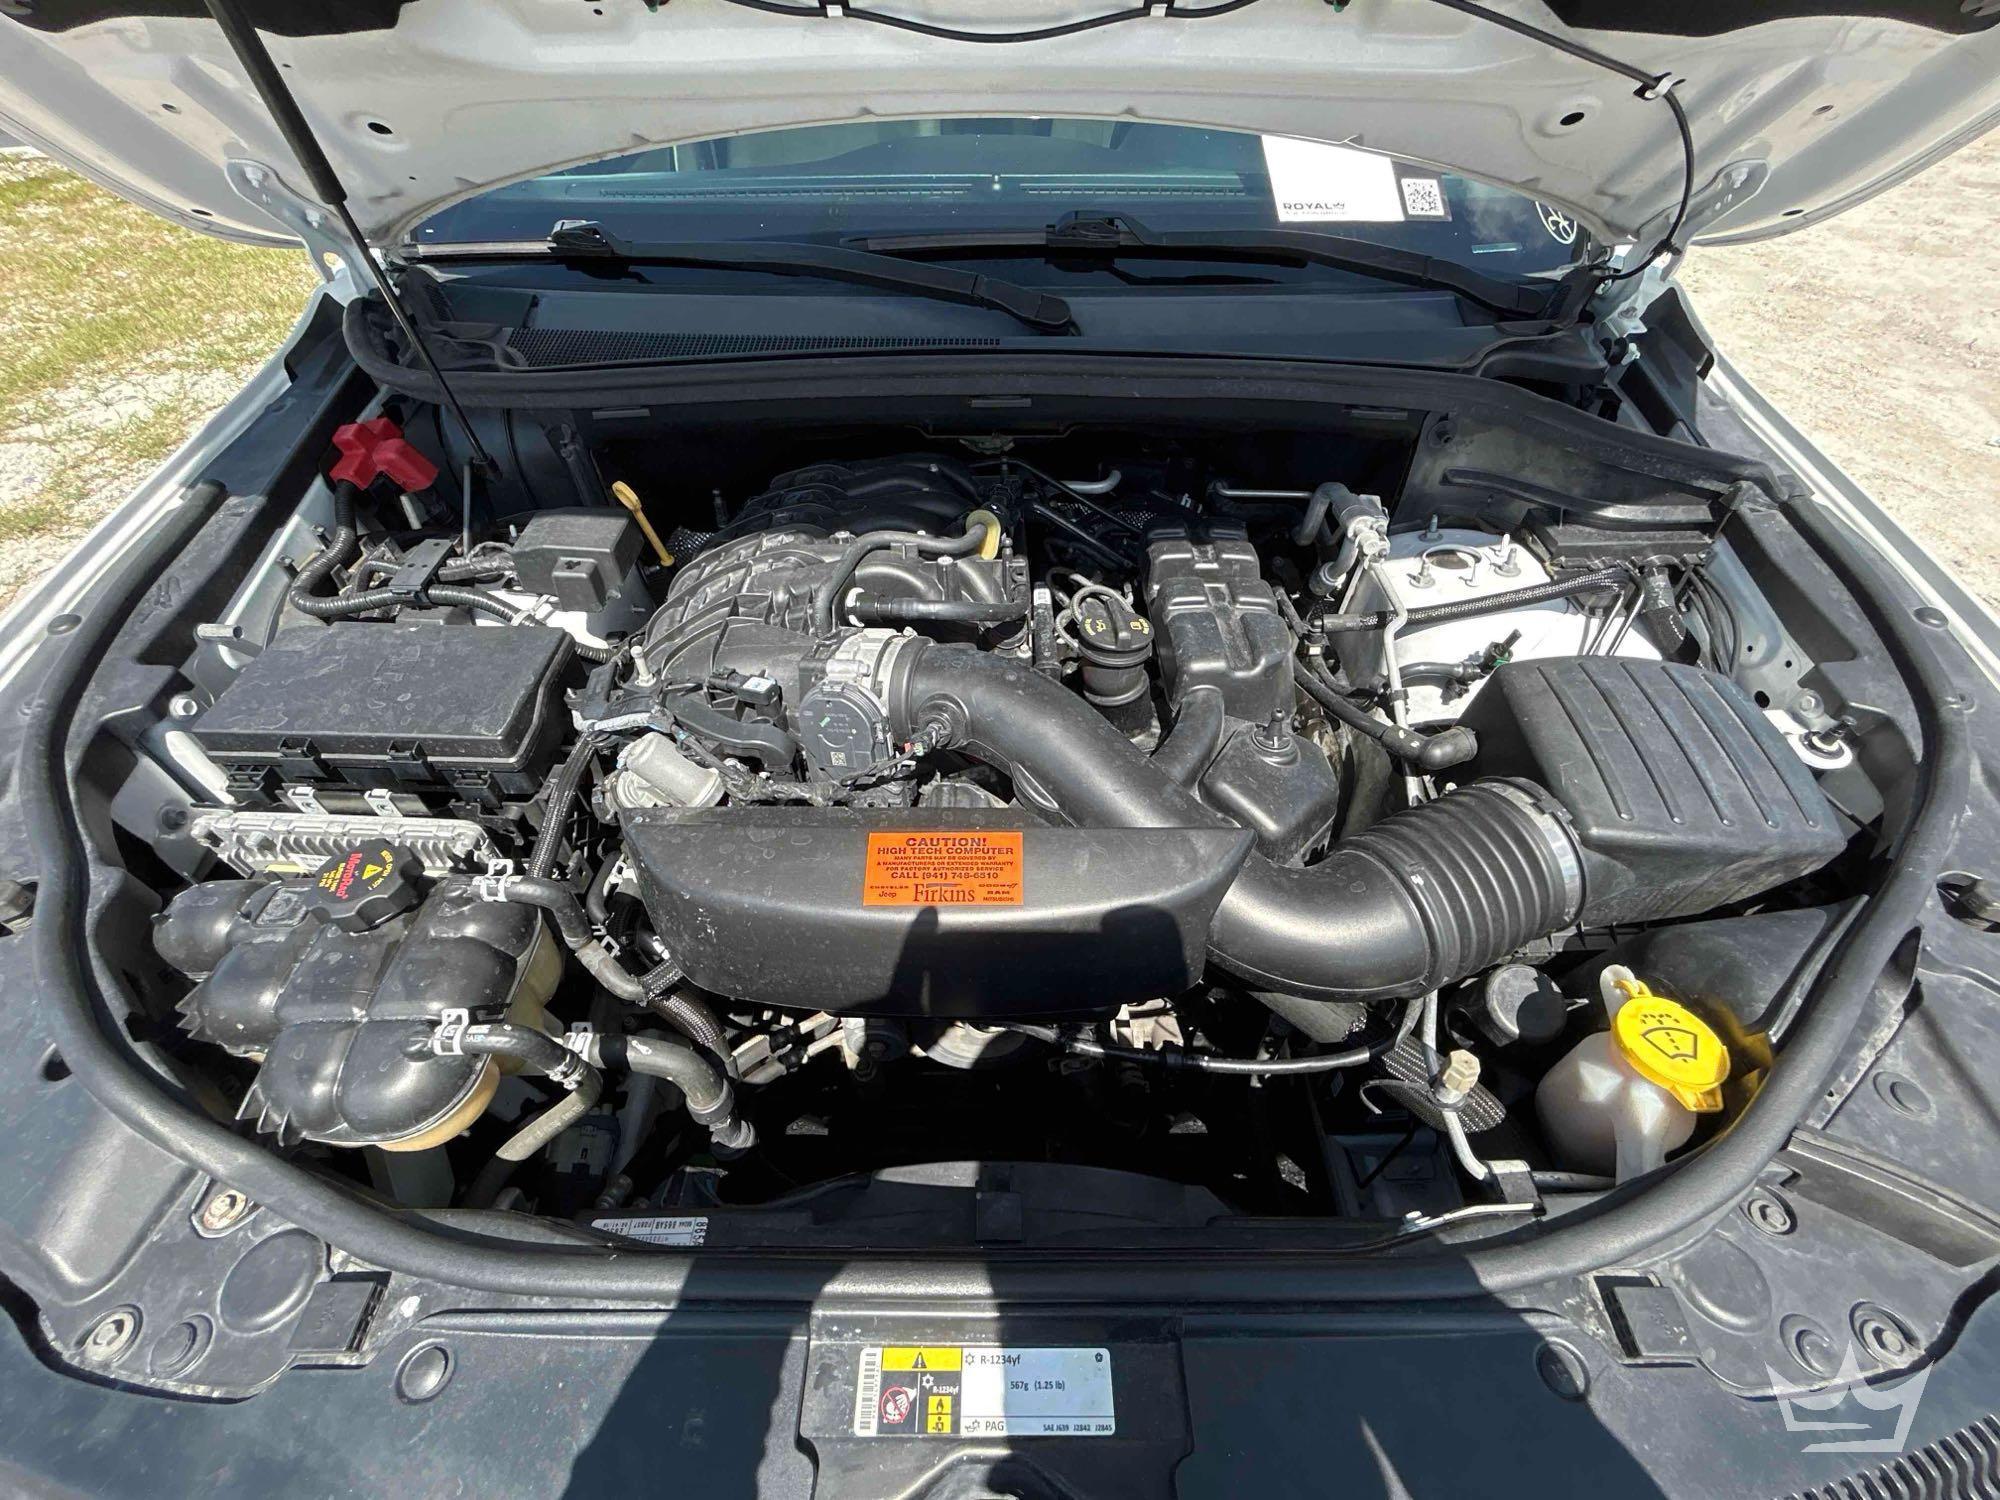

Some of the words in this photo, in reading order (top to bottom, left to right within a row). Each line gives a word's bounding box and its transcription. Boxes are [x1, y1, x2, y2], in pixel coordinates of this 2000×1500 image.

[905, 837, 987, 847] CAUTION!
[877, 847, 907, 855] HIGH
[910, 847, 942, 855] TECH
[946, 847, 1014, 855] COMPUTER
[922, 872, 948, 880] (941)
[913, 883, 975, 902] Firkins
[980, 1354, 1021, 1367] R-1234yf
[1010, 1381, 1029, 1391] 567g
[1034, 1380, 1054, 1391] (1.25
[1055, 1380, 1066, 1391] lb)
[985, 1421, 1005, 1431] PAG
